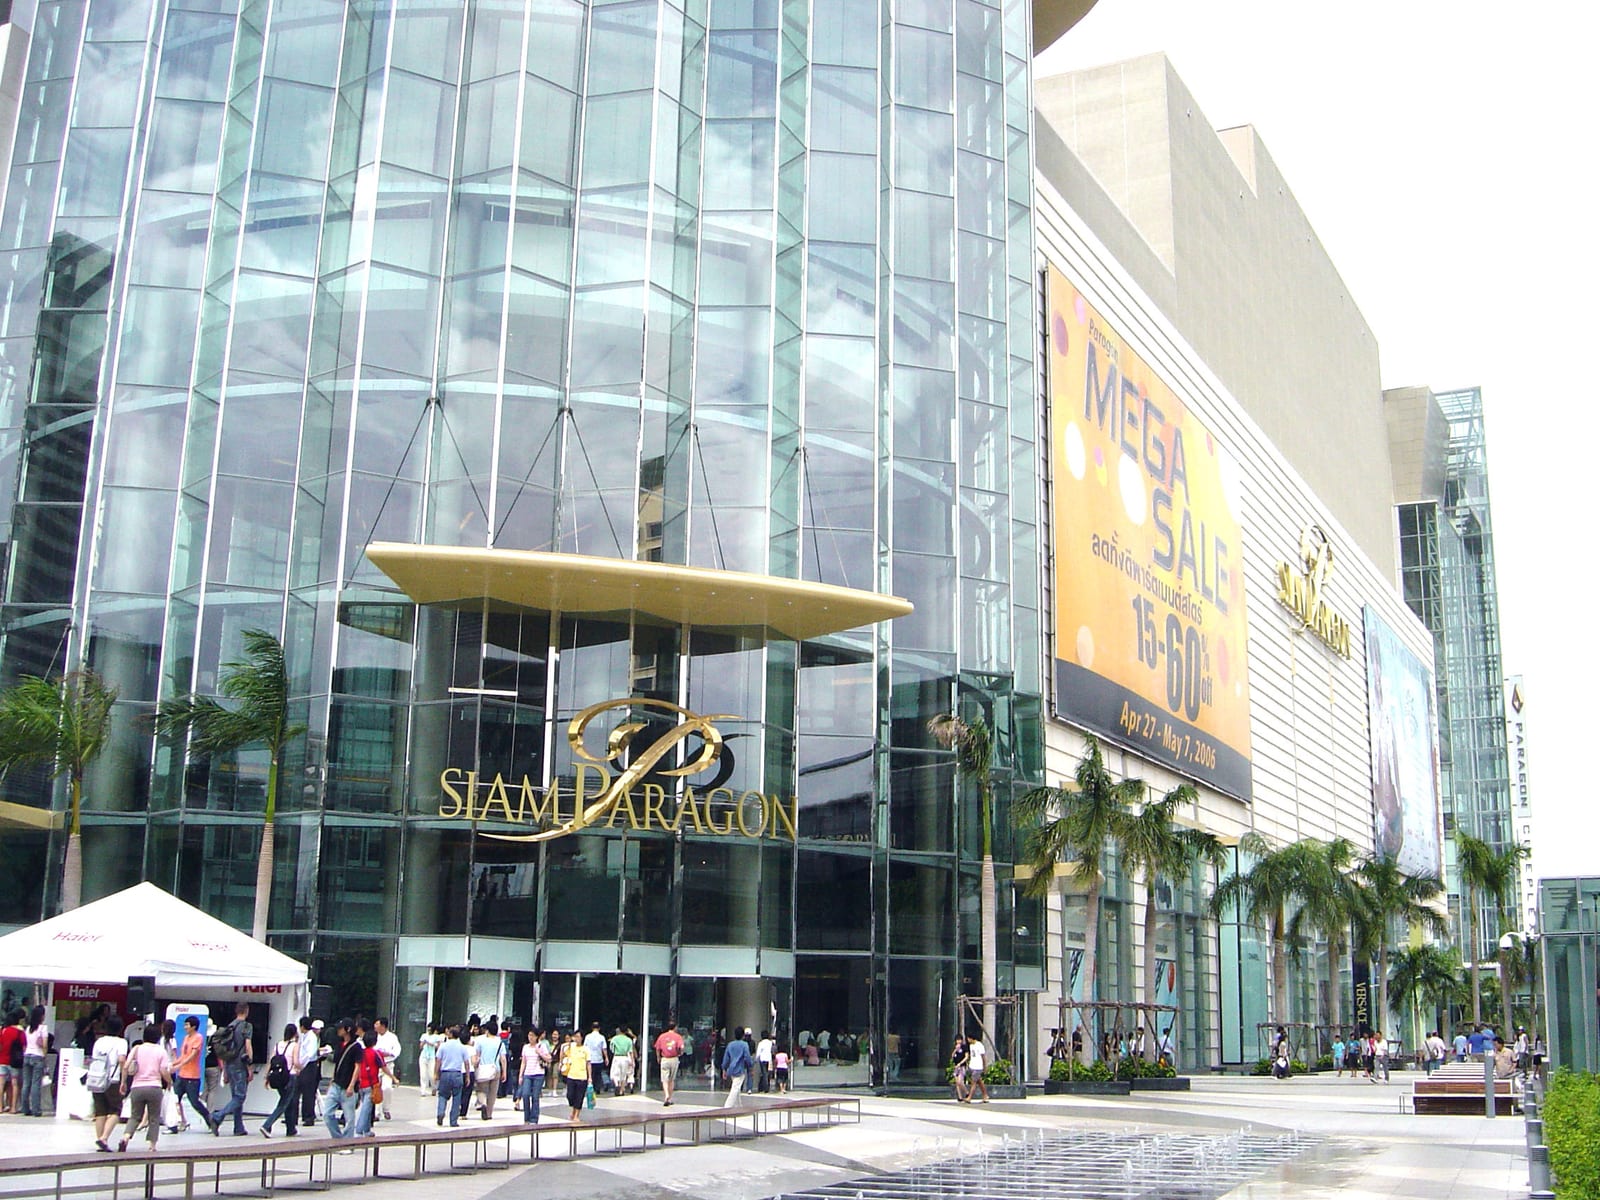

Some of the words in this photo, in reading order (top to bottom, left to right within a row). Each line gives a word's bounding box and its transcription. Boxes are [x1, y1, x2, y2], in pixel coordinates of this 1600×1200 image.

[1084, 340, 1190, 506] MEGA
[1152, 487, 1228, 616] SALE
[1201, 676, 1213, 707] off
[1119, 701, 1142, 736] Apr
[1142, 713, 1157, 740] 27
[1162, 723, 1183, 760] May
[1183, 736, 1194, 763] 7,
[1194, 740, 1216, 769] 2006
[1515, 722, 1528, 808] PARAGON
[439, 767, 561, 825] SIAM
[571, 762, 797, 841] PARAGON
[1523, 825, 1536, 934] CIEPLEX
[52, 931, 105, 942] Haier
[69, 985, 100, 998] Haier
[1356, 982, 1368, 1025] VERSACE
[62, 1058, 70, 1087] Haier
